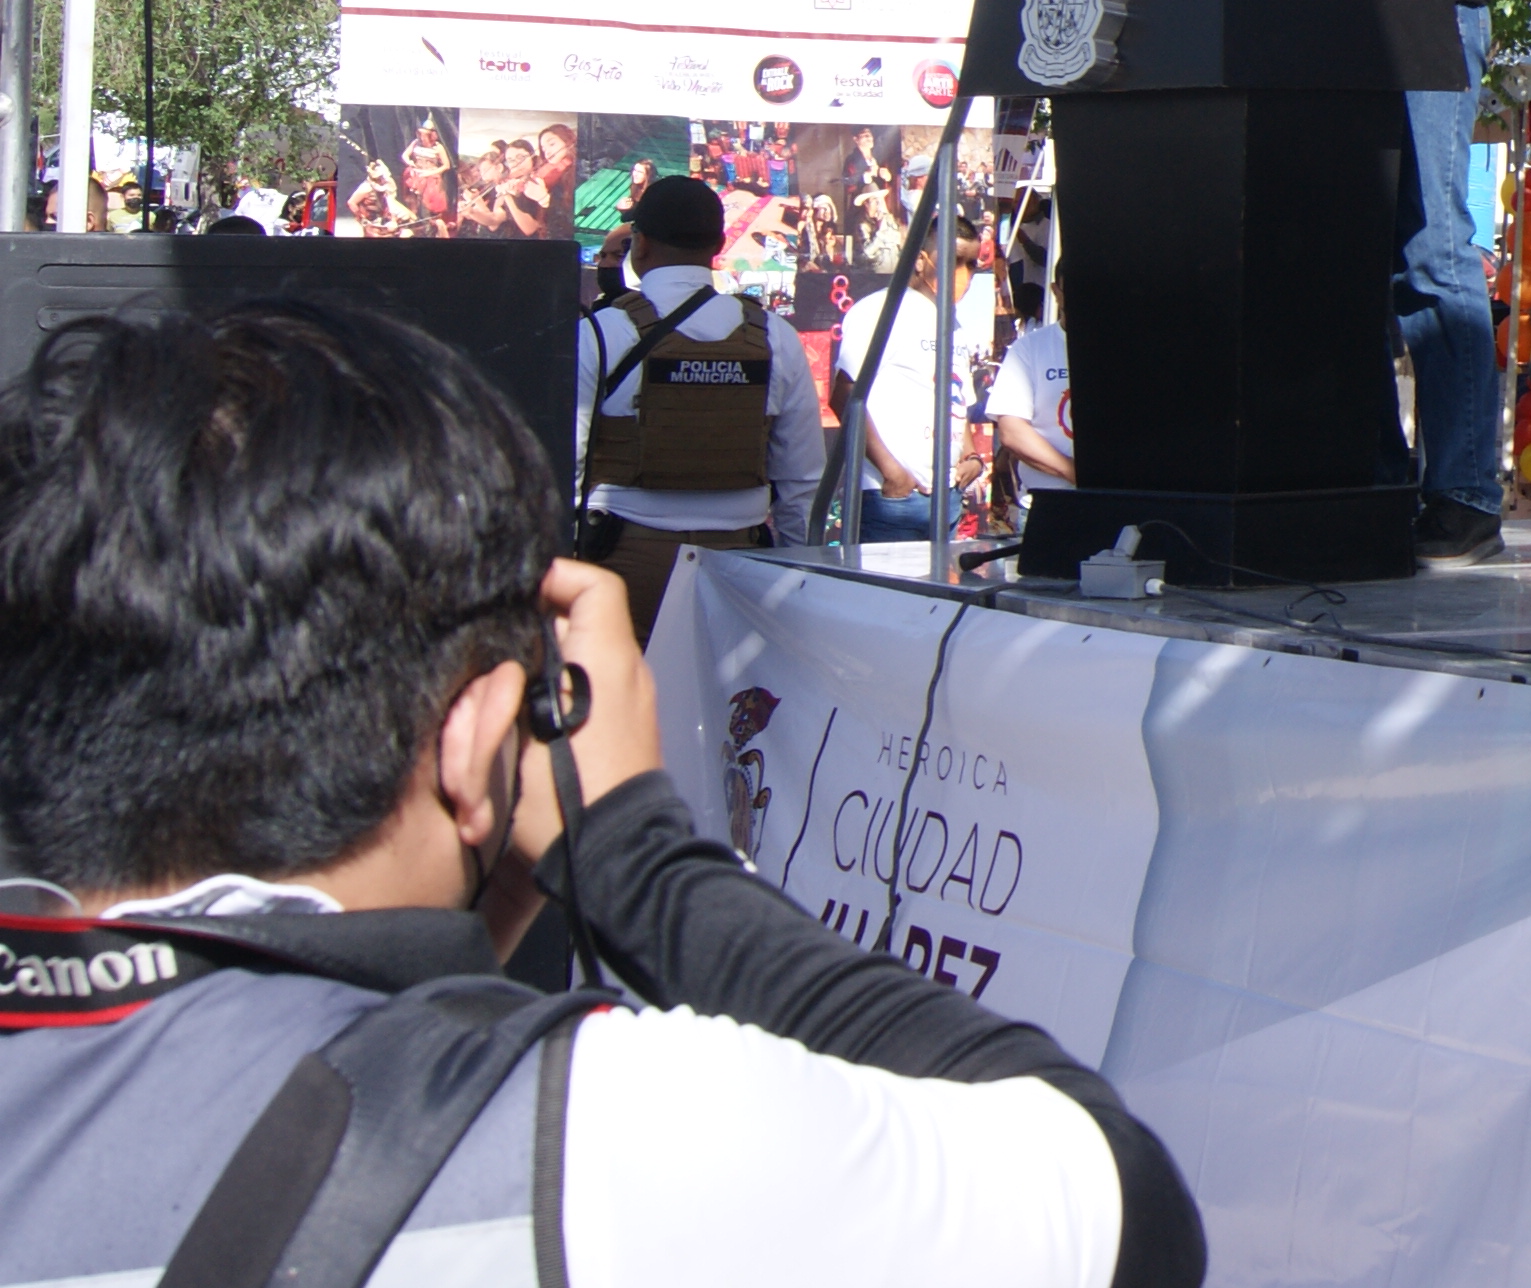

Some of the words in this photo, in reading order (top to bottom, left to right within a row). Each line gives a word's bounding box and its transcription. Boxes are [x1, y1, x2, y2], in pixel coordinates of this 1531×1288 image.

[834, 73, 883, 88] festival
[680, 360, 743, 373] POLICIA
[670, 371, 750, 384] MUNICIPAL
[877, 730, 1009, 798] HEROICA
[833, 789, 1023, 916] CIUDAD
